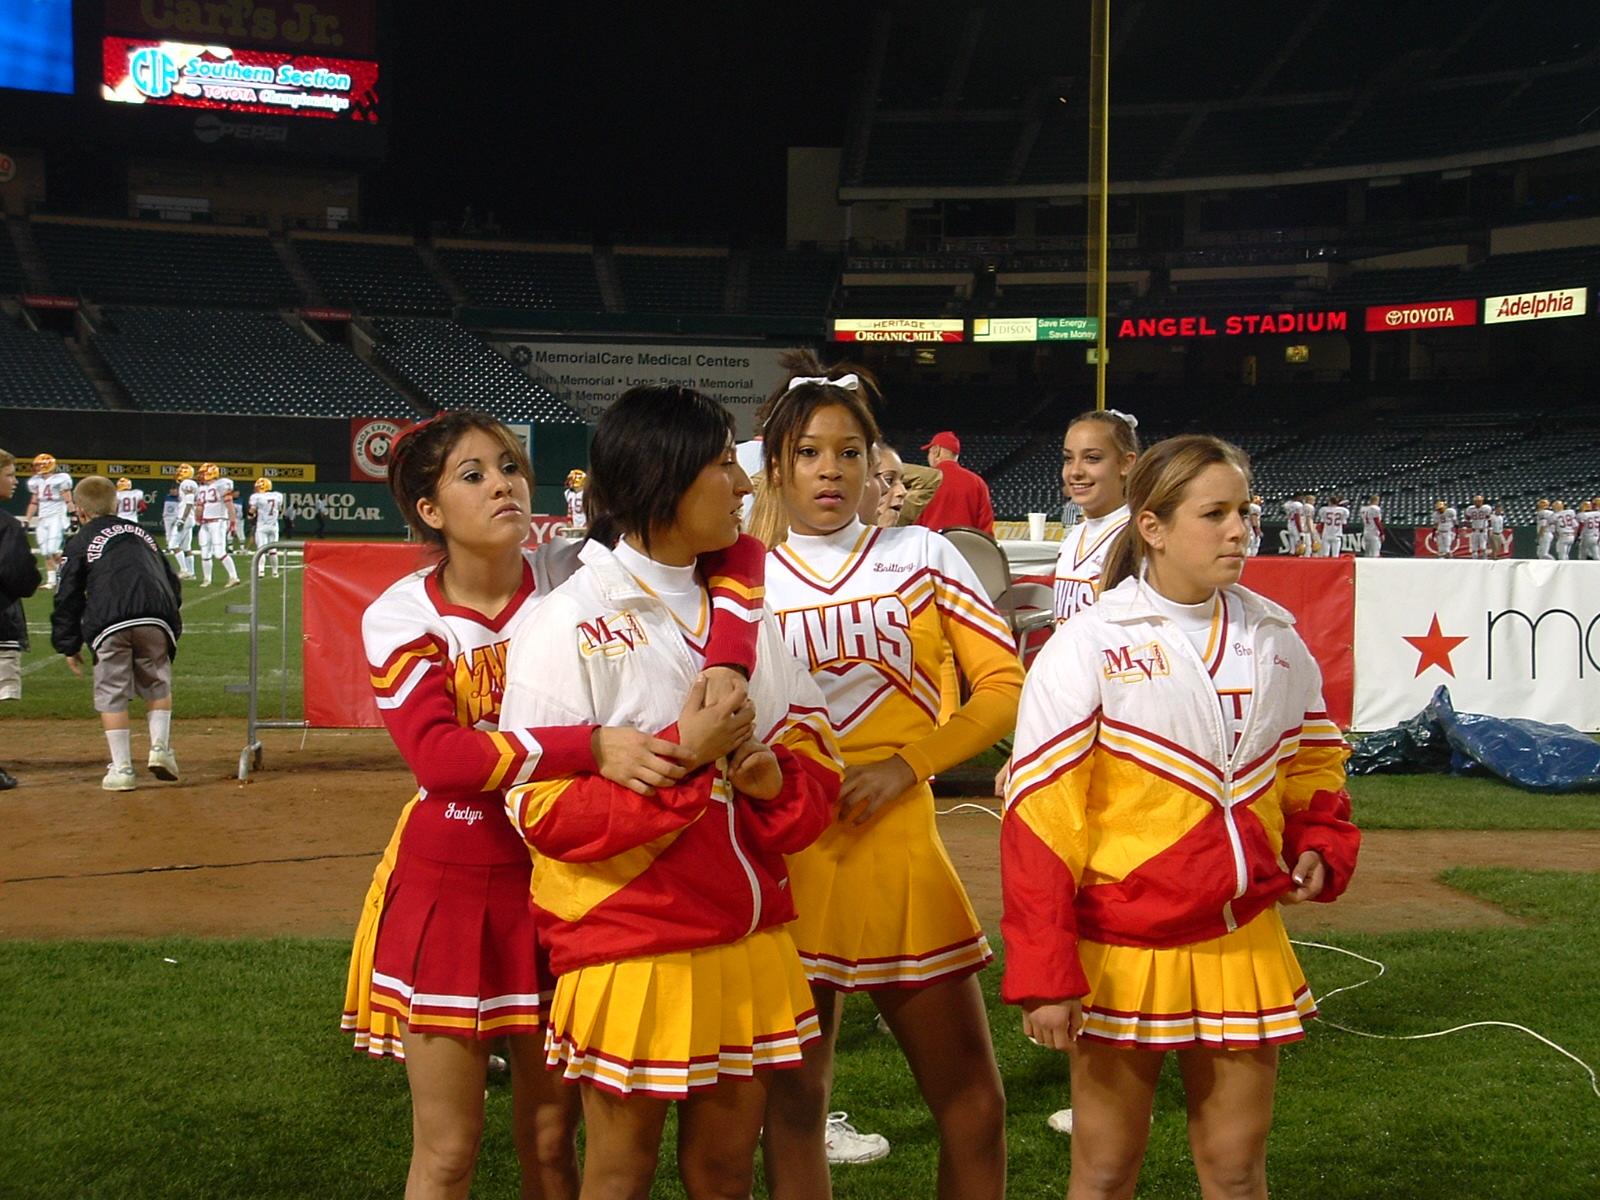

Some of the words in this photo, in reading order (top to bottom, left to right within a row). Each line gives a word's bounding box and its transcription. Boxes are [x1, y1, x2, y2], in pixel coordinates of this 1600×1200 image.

[142, 0, 277, 39] Carl's
[282, 4, 344, 46] Jr.
[131, 48, 177, 96] CIF
[186, 59, 274, 82] Southern
[277, 65, 350, 89] Section
[204, 86, 257, 101] TOYOTA
[220, 123, 288, 141] PEPSI
[1496, 290, 1574, 318] Adelphia
[1402, 307, 1455, 324] TOYOTA
[873, 320, 926, 329] HERITAGE
[992, 325, 1033, 335] EDISON
[1038, 319, 1058, 328] Save
[1059, 318, 1087, 329] Energy
[1118, 317, 1217, 338] ANGEL
[1225, 311, 1348, 335] STADIUM
[855, 330, 913, 342] ORGANIC
[913, 330, 944, 341] MILK
[1048, 330, 1068, 339] Save
[535, 351, 633, 365] MemorialCare
[638, 353, 692, 366] Medical
[696, 354, 750, 368] Centers
[560, 375, 615, 386] Memorial
[701, 377, 753, 389] Memorial
[291, 507, 381, 520] POULAR
[1326, 511, 1342, 526] 52
[444, 802, 484, 826] Jaclyn
